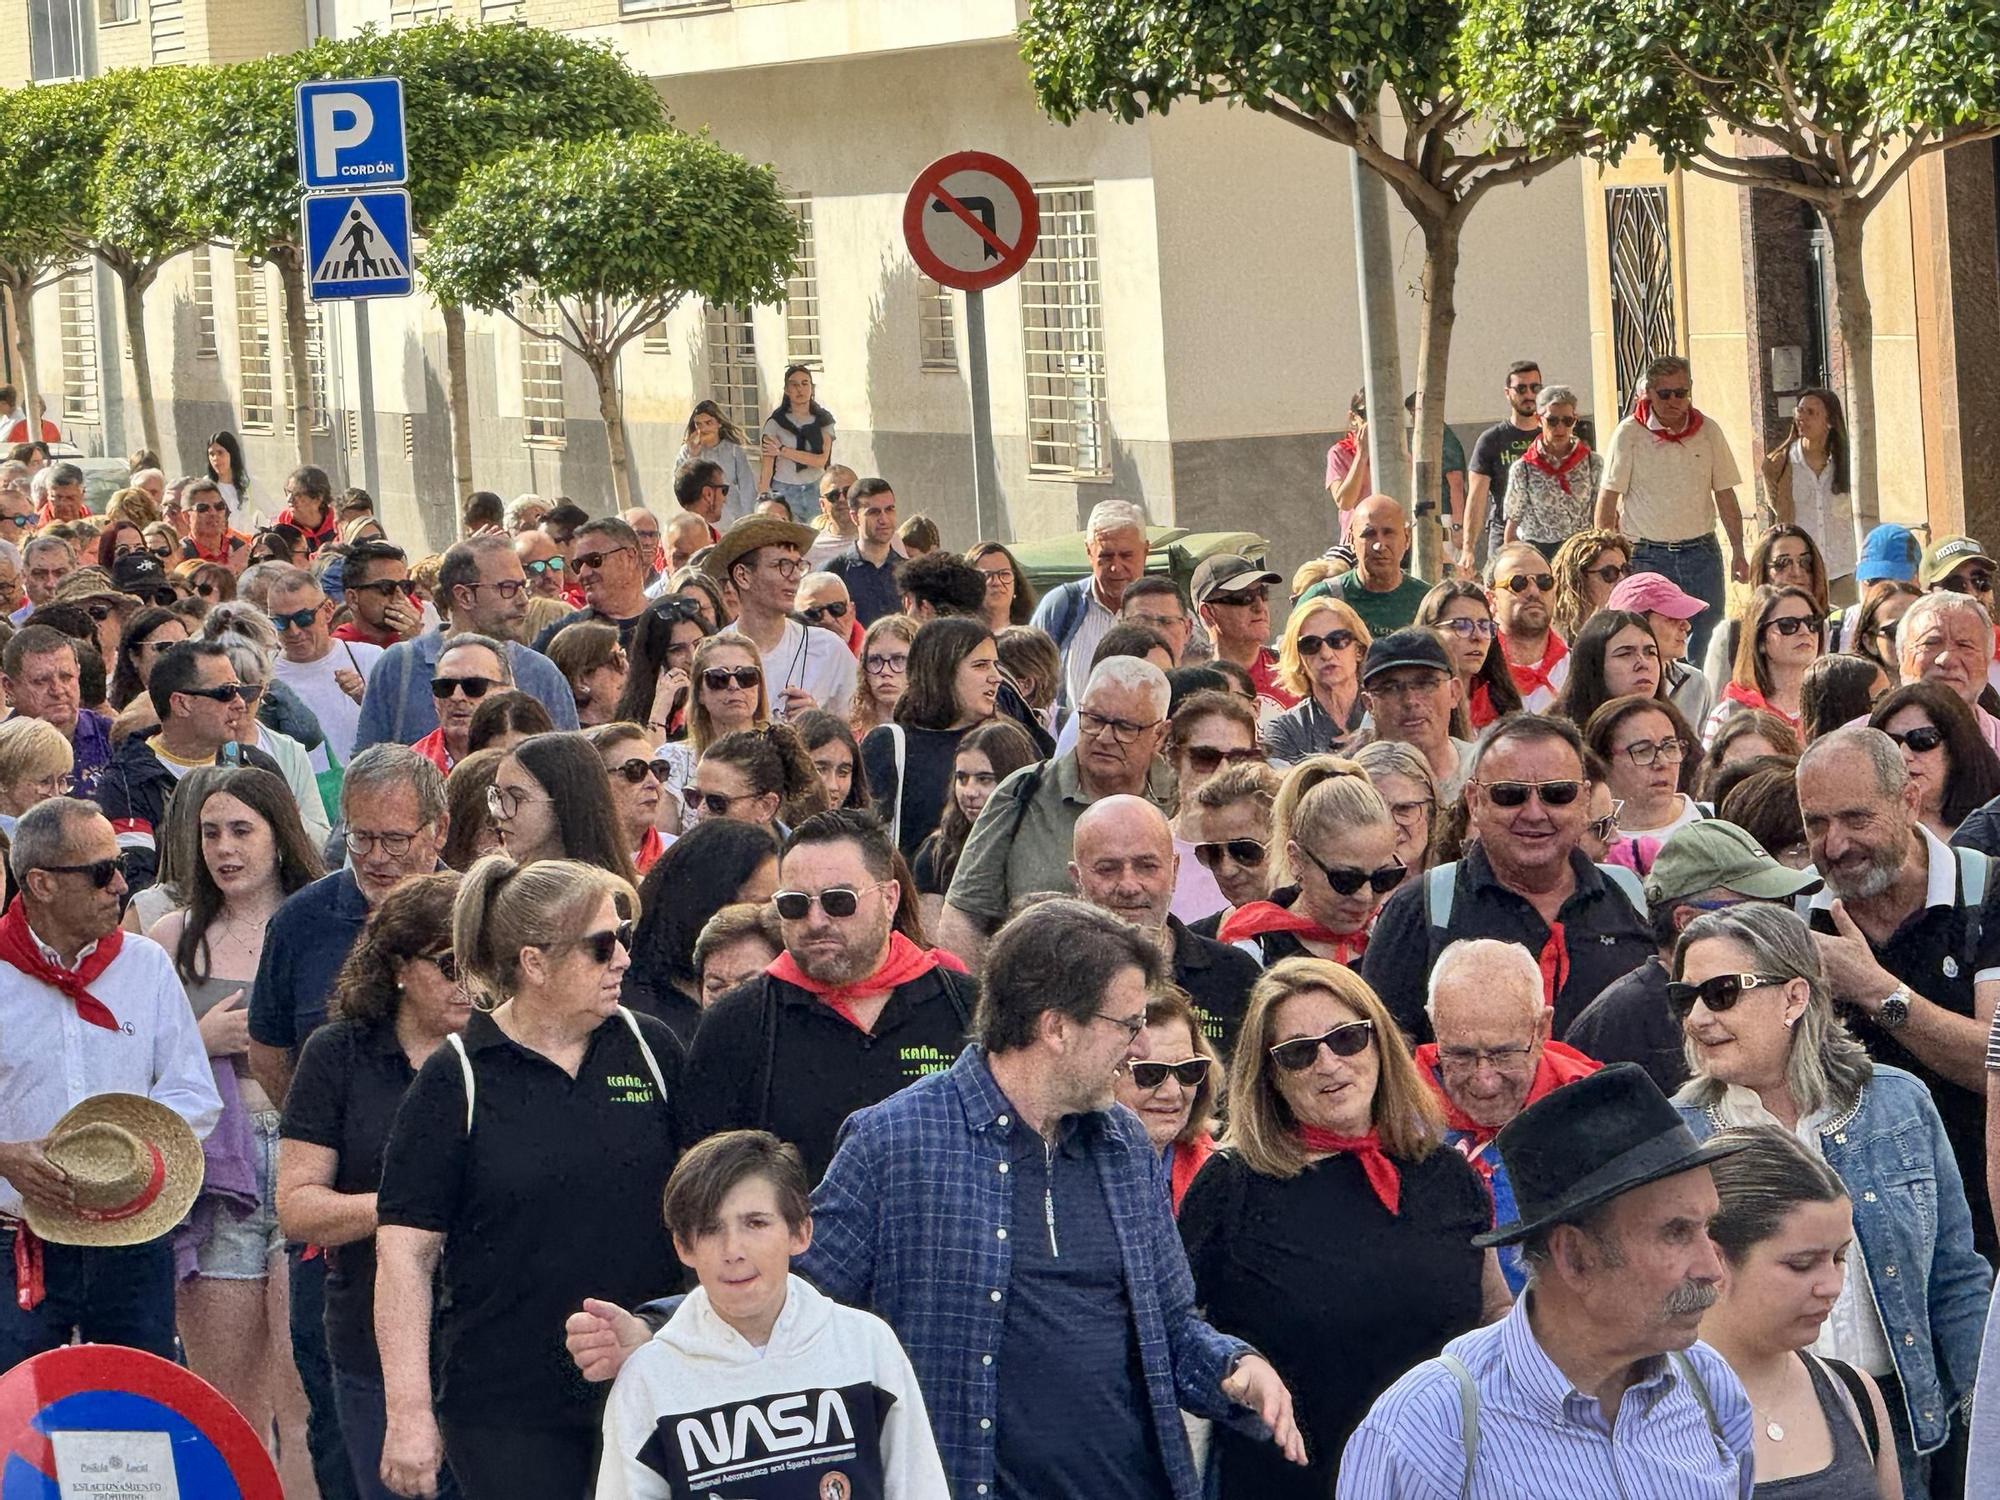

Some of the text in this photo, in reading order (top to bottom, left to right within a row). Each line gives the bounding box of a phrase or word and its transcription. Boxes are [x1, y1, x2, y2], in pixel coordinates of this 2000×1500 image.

[312, 93, 374, 177] P
[341, 161, 394, 176] CORDÓN
[677, 1390, 854, 1471] NASA
[786, 1460, 810, 1471] Space
